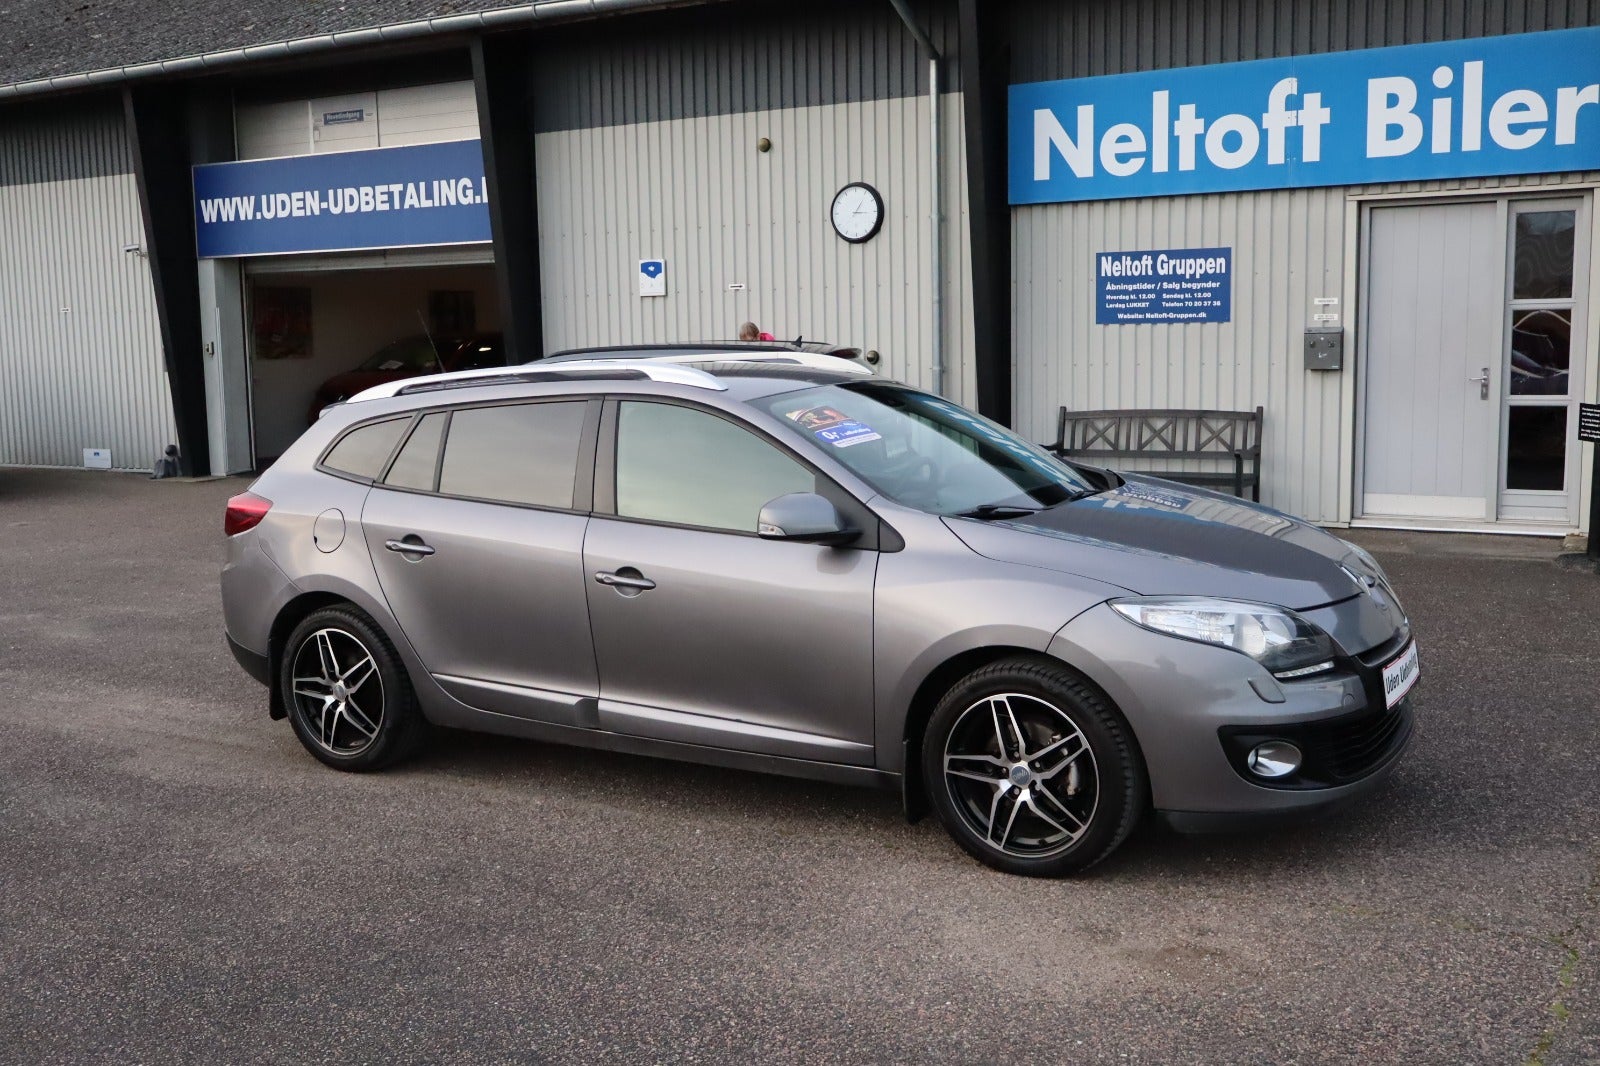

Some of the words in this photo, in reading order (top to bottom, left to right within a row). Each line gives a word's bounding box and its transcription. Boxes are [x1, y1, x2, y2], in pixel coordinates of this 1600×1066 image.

[1033, 77, 1331, 181] Neltoft
[1366, 60, 1599, 159] Biler
[1101, 255, 1153, 277] Neltoft
[1156, 253, 1226, 279] Gruppen
[1106, 281, 1156, 291] Åbningstider
[1162, 281, 1180, 290] Salg
[1182, 280, 1221, 290] begynder
[1385, 673, 1400, 695] Uden
